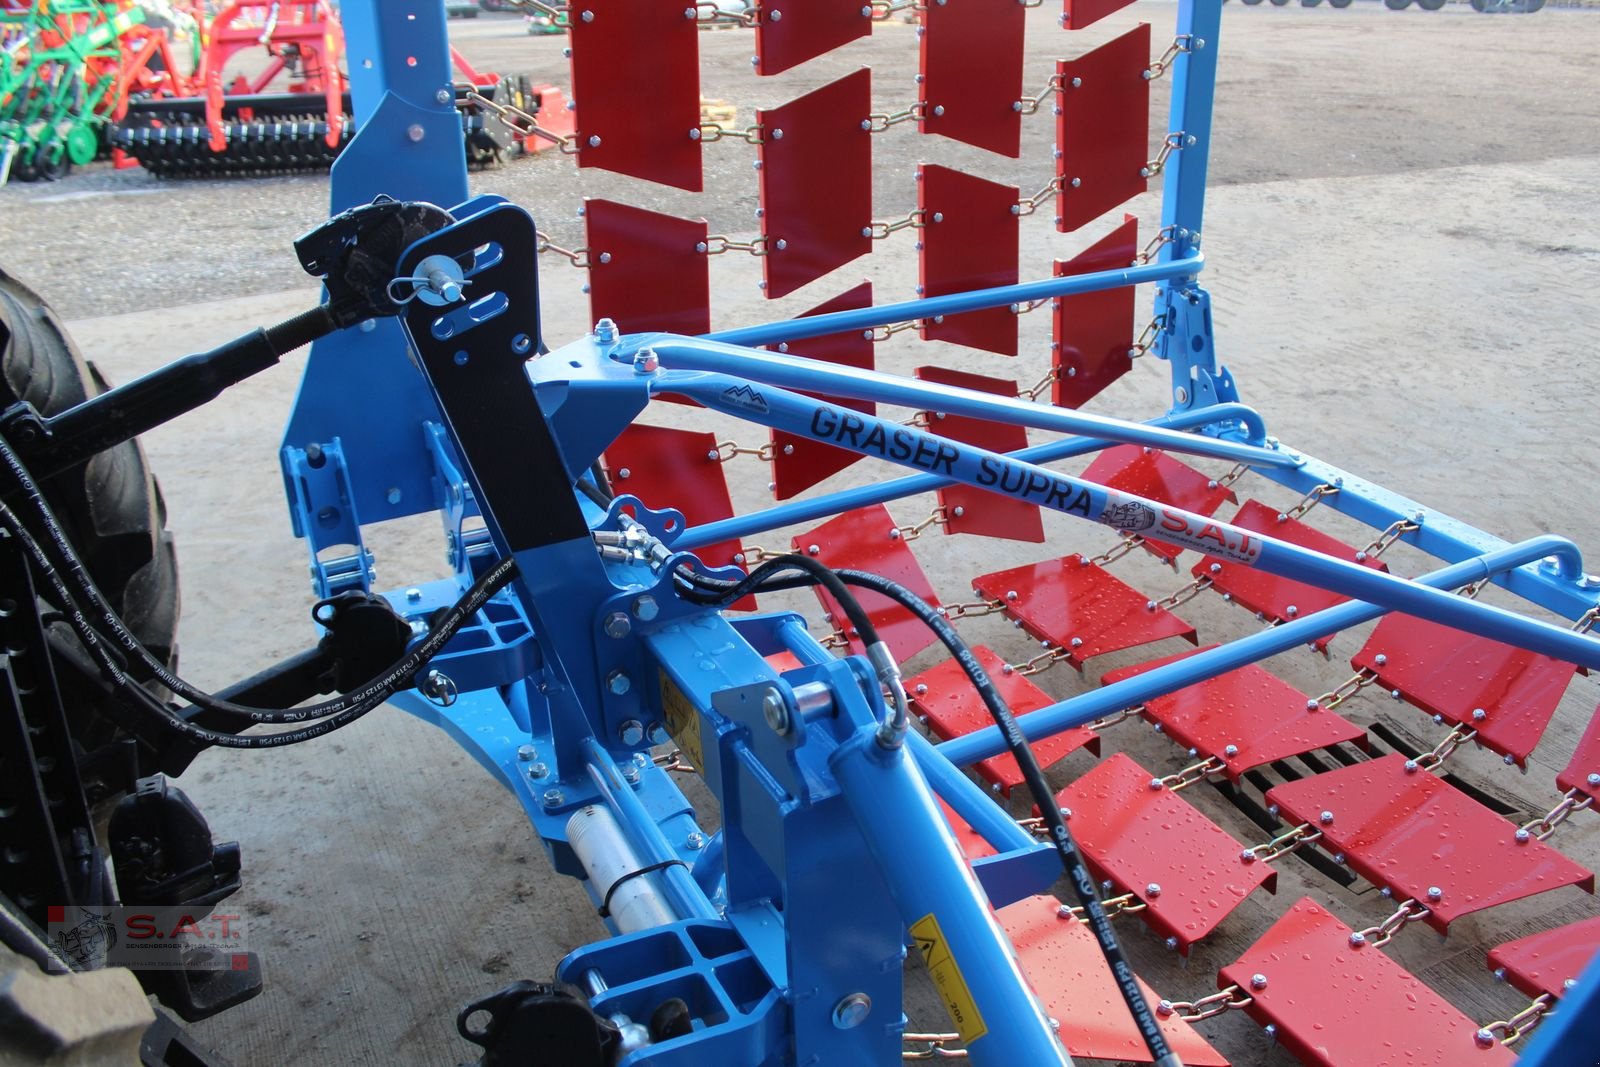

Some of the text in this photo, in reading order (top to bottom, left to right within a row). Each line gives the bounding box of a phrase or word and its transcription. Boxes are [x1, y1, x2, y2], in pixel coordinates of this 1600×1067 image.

[810, 406, 1092, 516] GRASER SUPRA
[1161, 509, 1256, 557] S.A.T.
[487, 560, 512, 584] EC115-05
[73, 610, 97, 645] EC115-05
[104, 612, 185, 692] Winner EC115-05
[384, 672, 397, 686] BAR
[396, 662, 408, 677] 215
[960, 649, 1022, 747] Winner EC115-05
[293, 731, 307, 741] BAR
[308, 726, 323, 738] 215
[1140, 1011, 1158, 1036] BAR
[1150, 1035, 1168, 1057] 215
